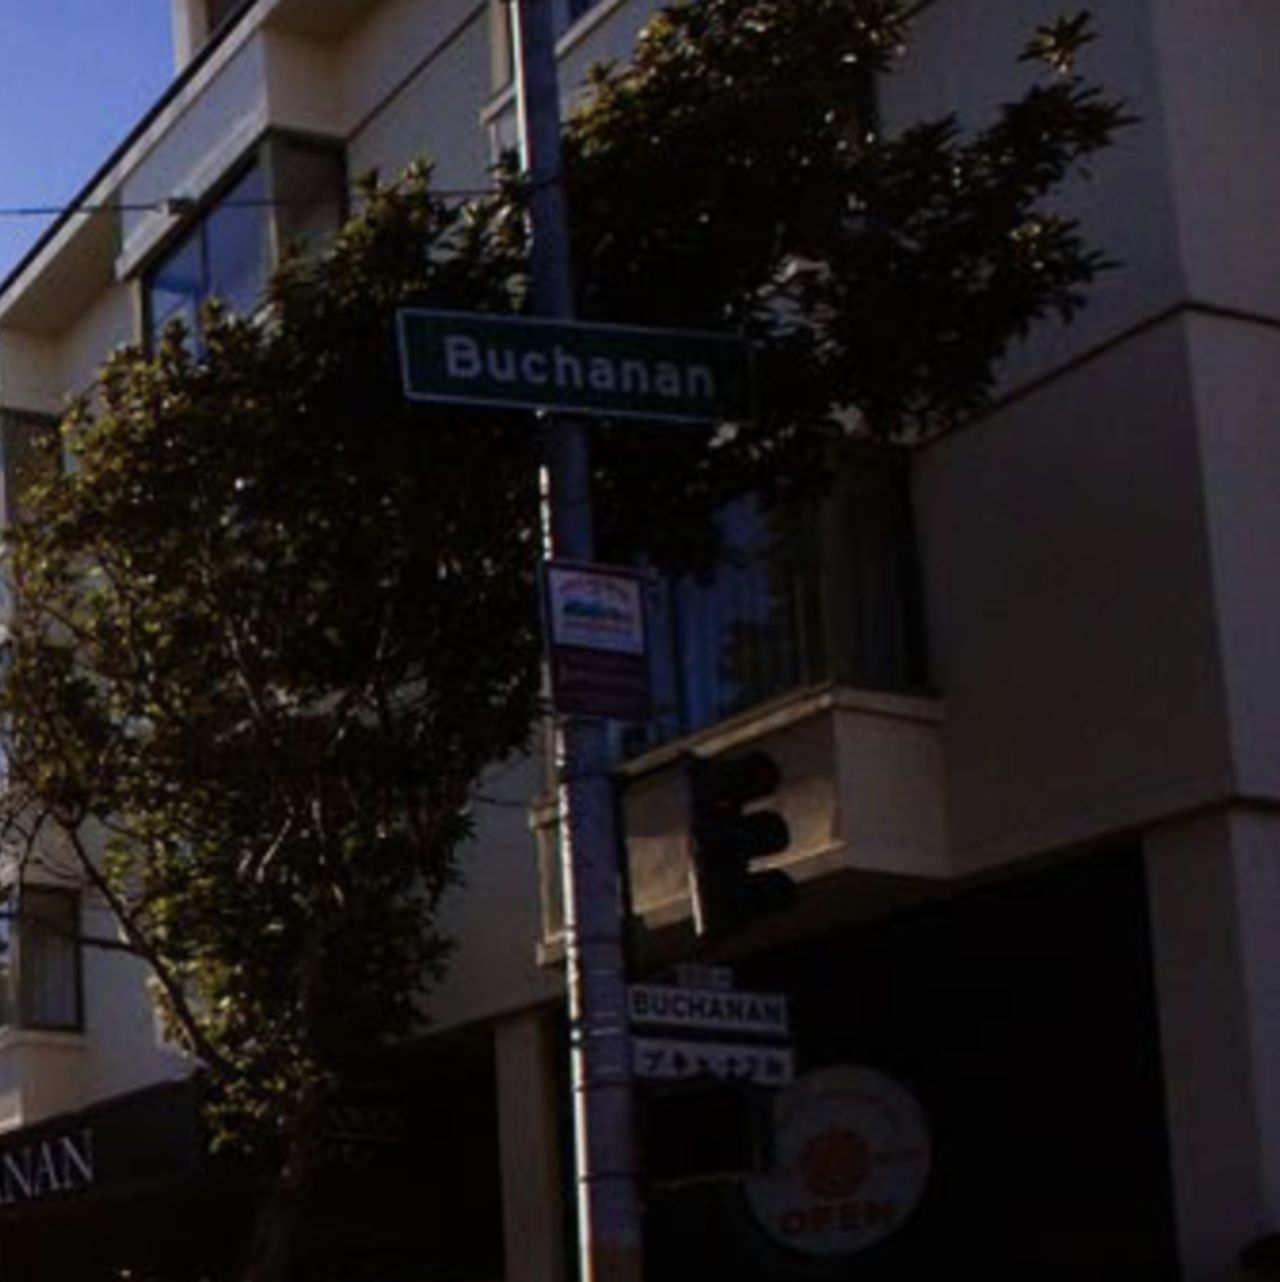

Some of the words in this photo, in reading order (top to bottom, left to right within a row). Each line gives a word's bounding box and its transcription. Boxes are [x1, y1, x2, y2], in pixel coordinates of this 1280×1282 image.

[442, 333, 715, 399] Buchanan
[632, 989, 782, 1024] BUCHANAN
[778, 1202, 893, 1236] OPEN
